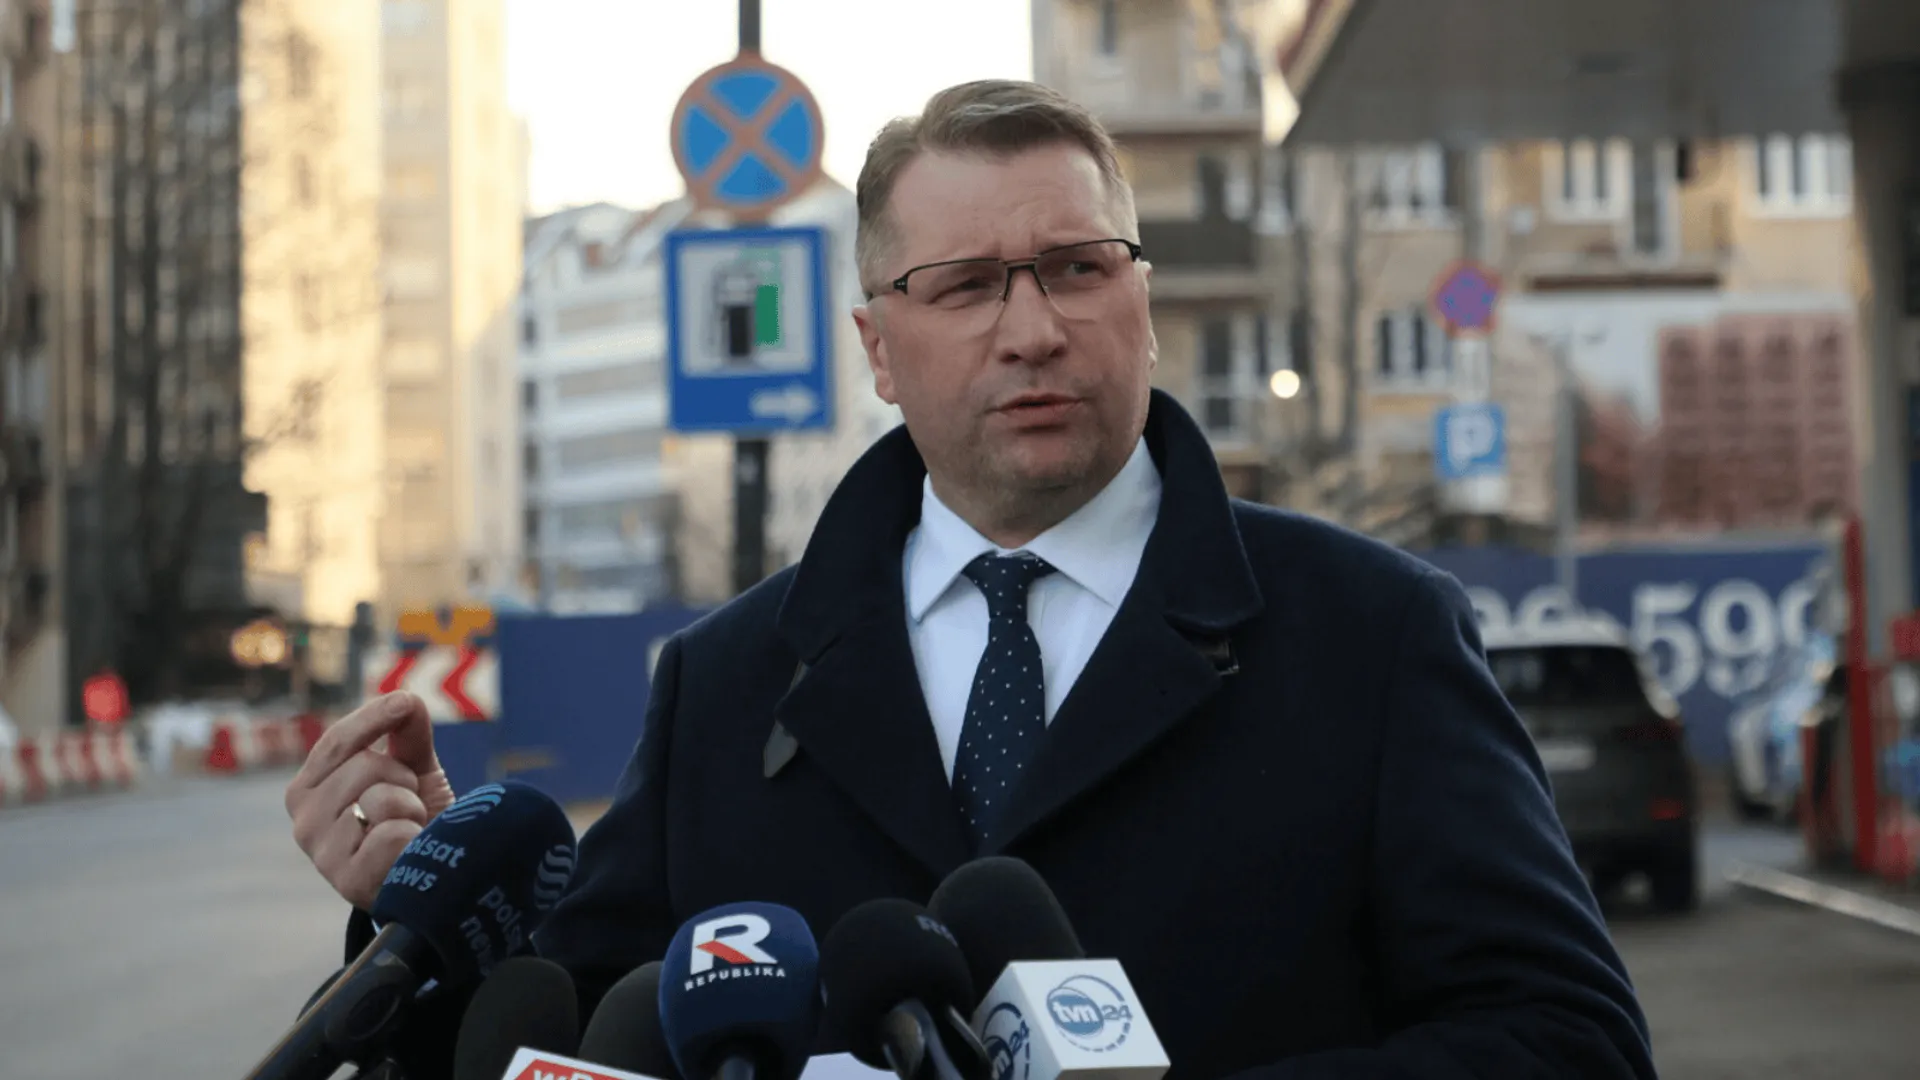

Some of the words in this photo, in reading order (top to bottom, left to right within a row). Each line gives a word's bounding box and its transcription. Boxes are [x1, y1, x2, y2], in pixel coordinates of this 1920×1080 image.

[1447, 411, 1495, 468] P
[690, 913, 778, 976] R
[684, 966, 786, 992] REPUBLIKA
